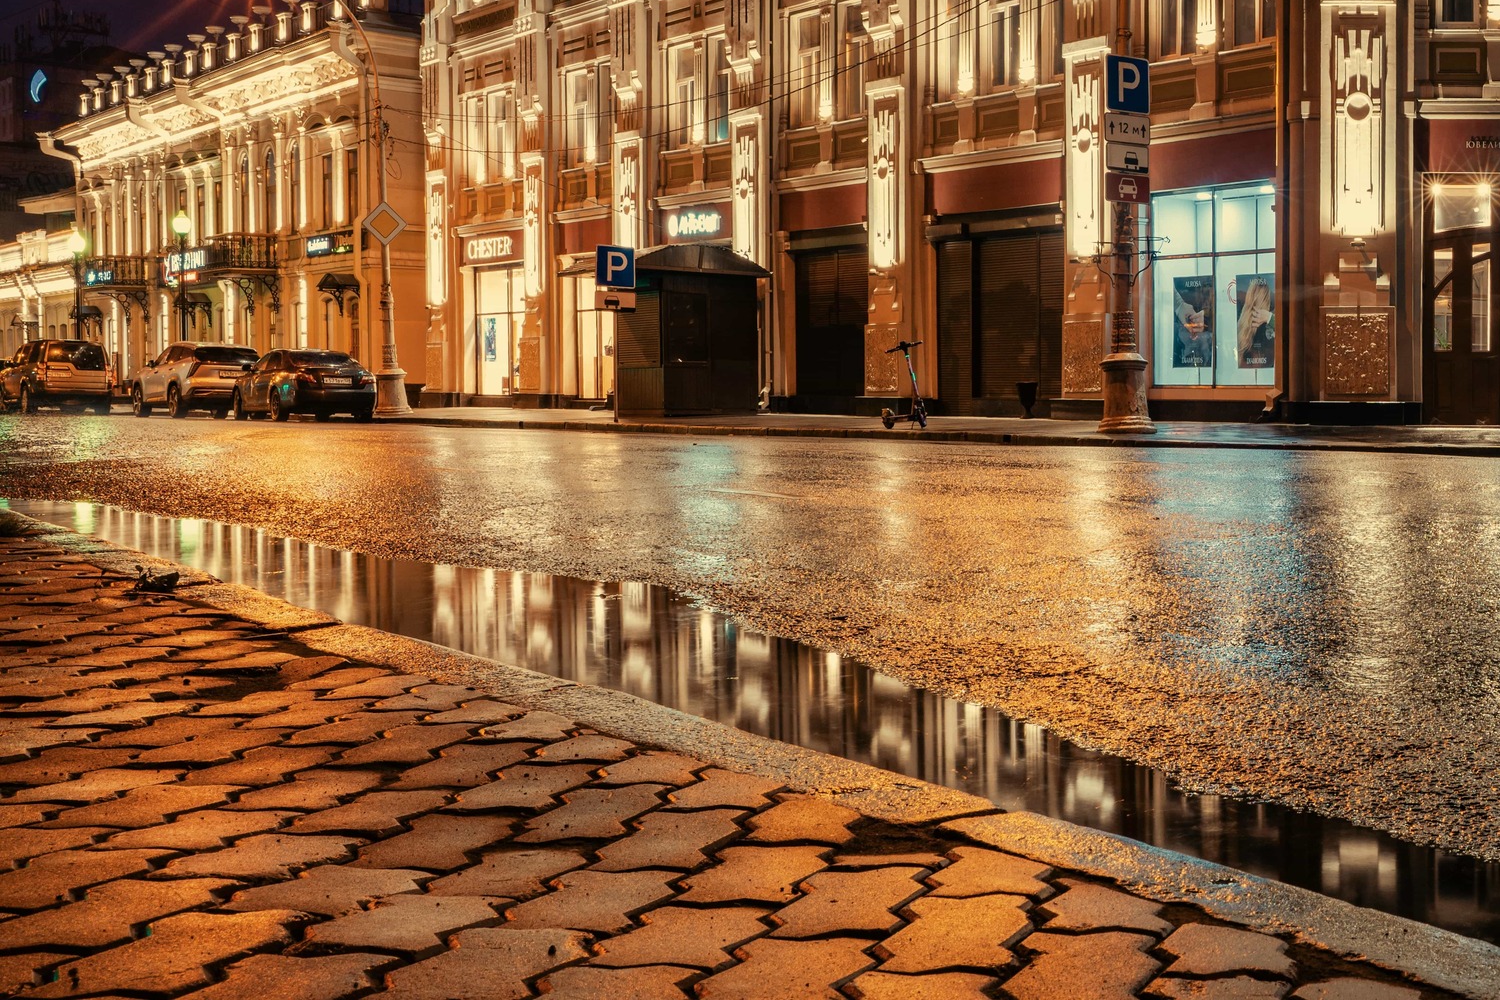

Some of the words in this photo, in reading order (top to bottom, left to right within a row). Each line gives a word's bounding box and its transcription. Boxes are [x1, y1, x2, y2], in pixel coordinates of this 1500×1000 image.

[1118, 61, 1141, 103] P
[1118, 122, 1129, 134] 12
[467, 235, 513, 260] CHESTER
[606, 251, 628, 282] P
[1184, 280, 1202, 288] ALROSA
